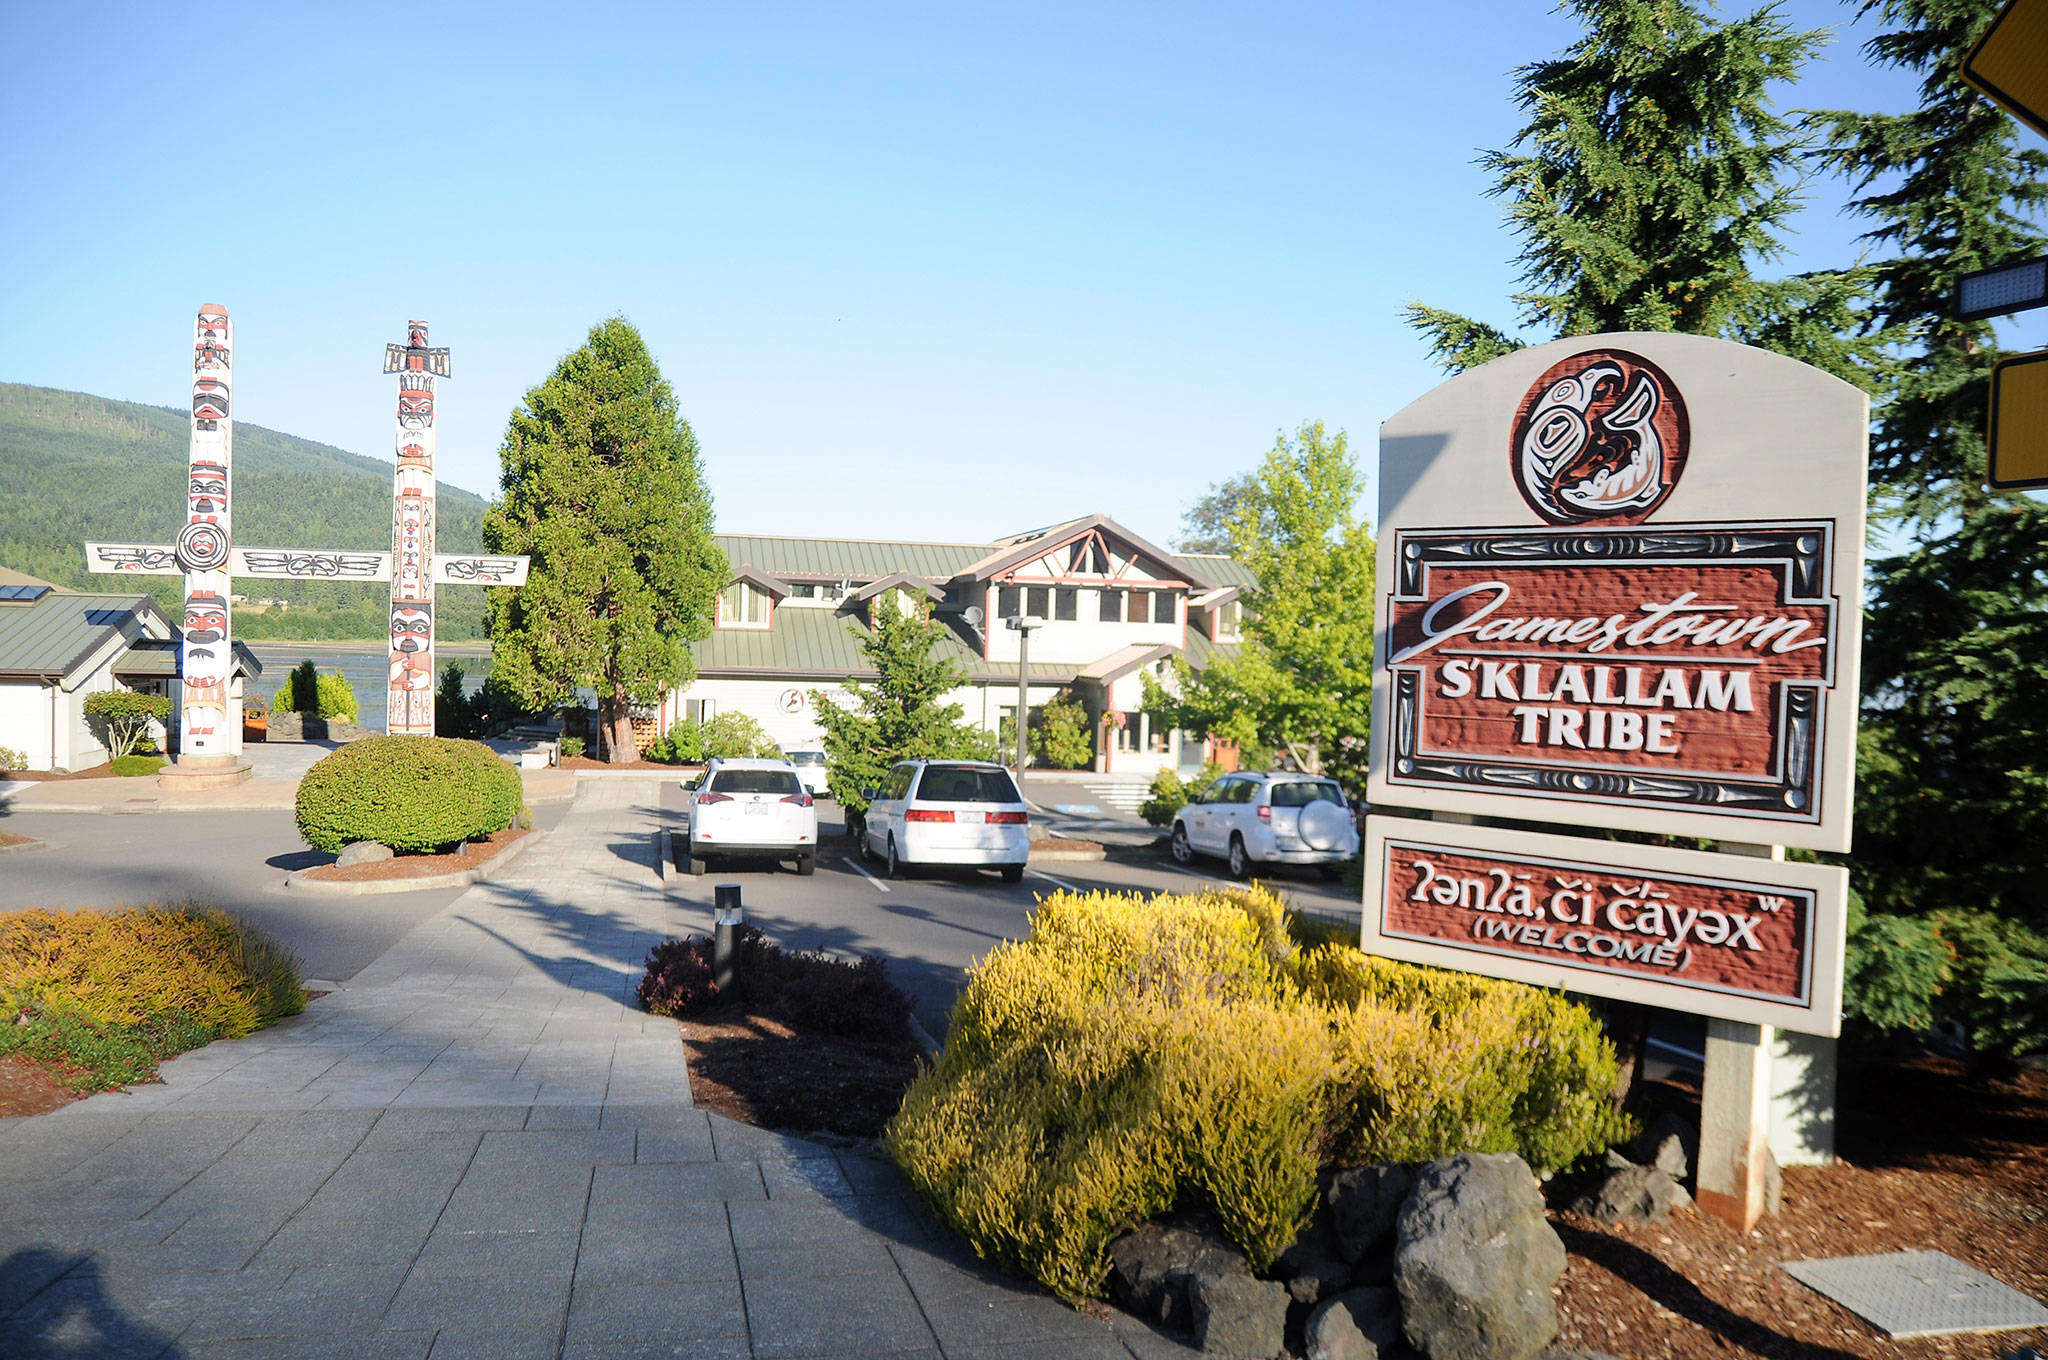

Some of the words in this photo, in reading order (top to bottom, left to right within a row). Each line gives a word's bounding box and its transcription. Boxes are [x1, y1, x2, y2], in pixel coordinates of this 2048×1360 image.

[1389, 581, 1826, 664] Jamestown
[1442, 658, 1755, 711] S'KLALLAM
[1514, 706, 1678, 754] TRIBE
[1473, 915, 1691, 971] (WELCOME)
